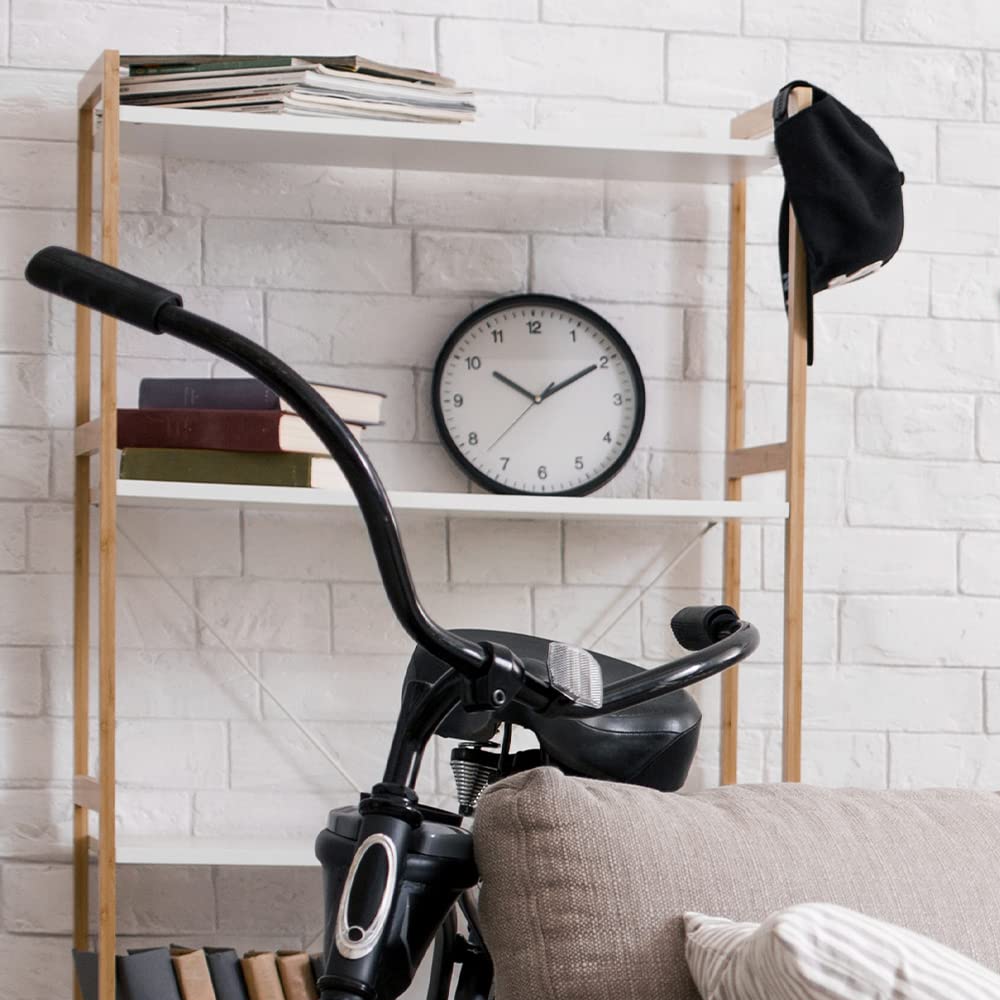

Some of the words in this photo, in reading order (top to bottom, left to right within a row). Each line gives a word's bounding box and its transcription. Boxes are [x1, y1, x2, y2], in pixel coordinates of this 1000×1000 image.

[526, 321, 542, 335] 12
[491, 330, 503, 343] 11
[570, 330, 577, 342] 1
[465, 356, 481, 369] 10
[599, 357, 609, 369] 2
[453, 394, 463, 407] 9
[613, 393, 623, 406] 3
[468, 432, 478, 445] 8
[602, 432, 612, 443] 4
[500, 457, 510, 470] 7
[574, 456, 584, 470] 5
[537, 466, 548, 480] 6
